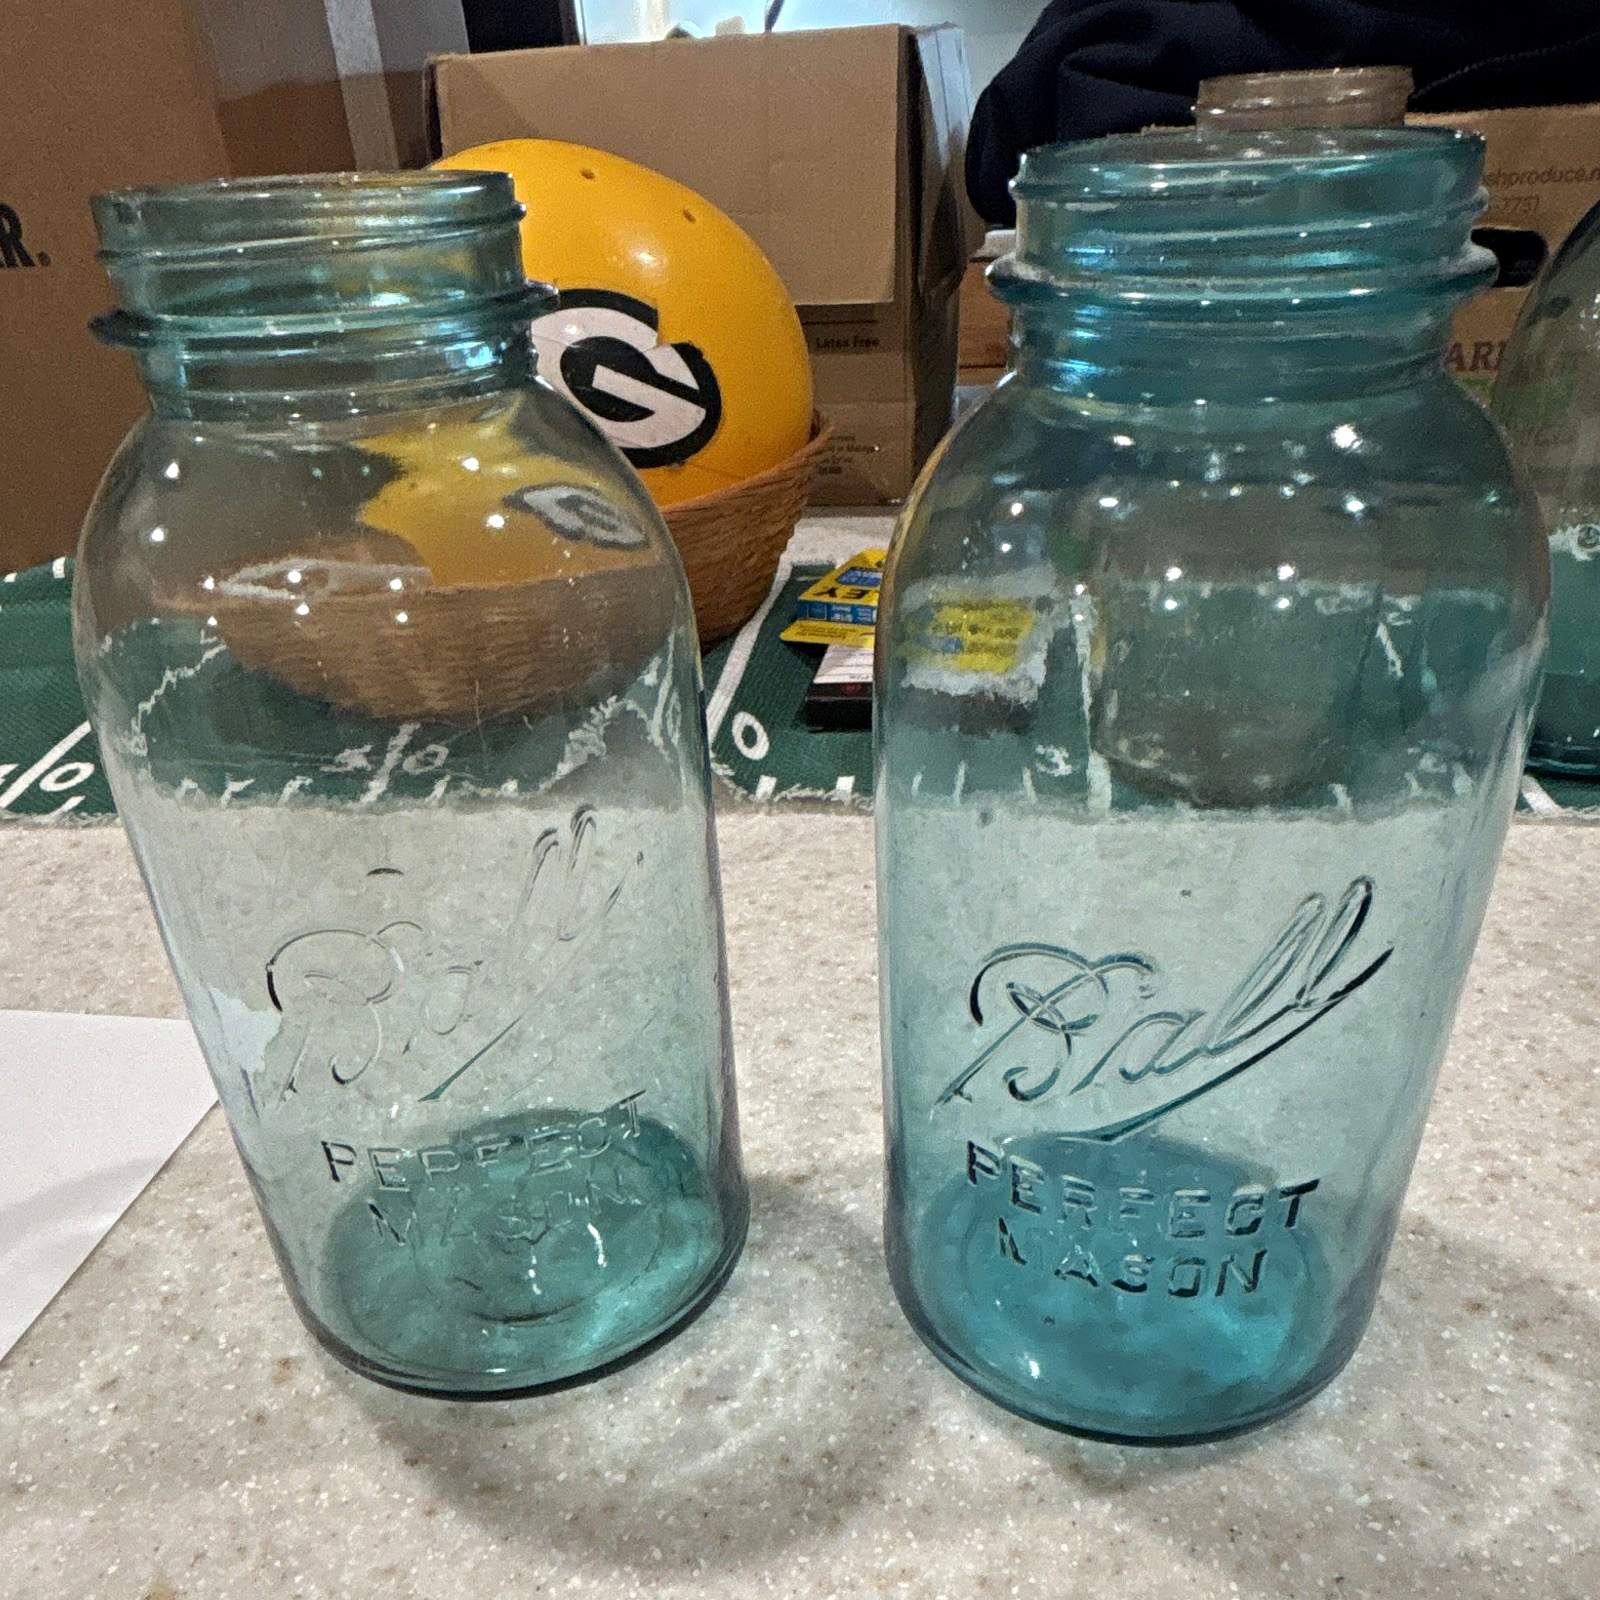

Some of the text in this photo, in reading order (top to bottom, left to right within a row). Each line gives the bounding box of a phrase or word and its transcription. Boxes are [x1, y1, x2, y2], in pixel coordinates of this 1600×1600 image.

[853, 337, 880, 349] Free
[930, 874, 1395, 1142] Ball
[966, 1139, 1321, 1239] PERFECT
[998, 1216, 1269, 1298] MASON
